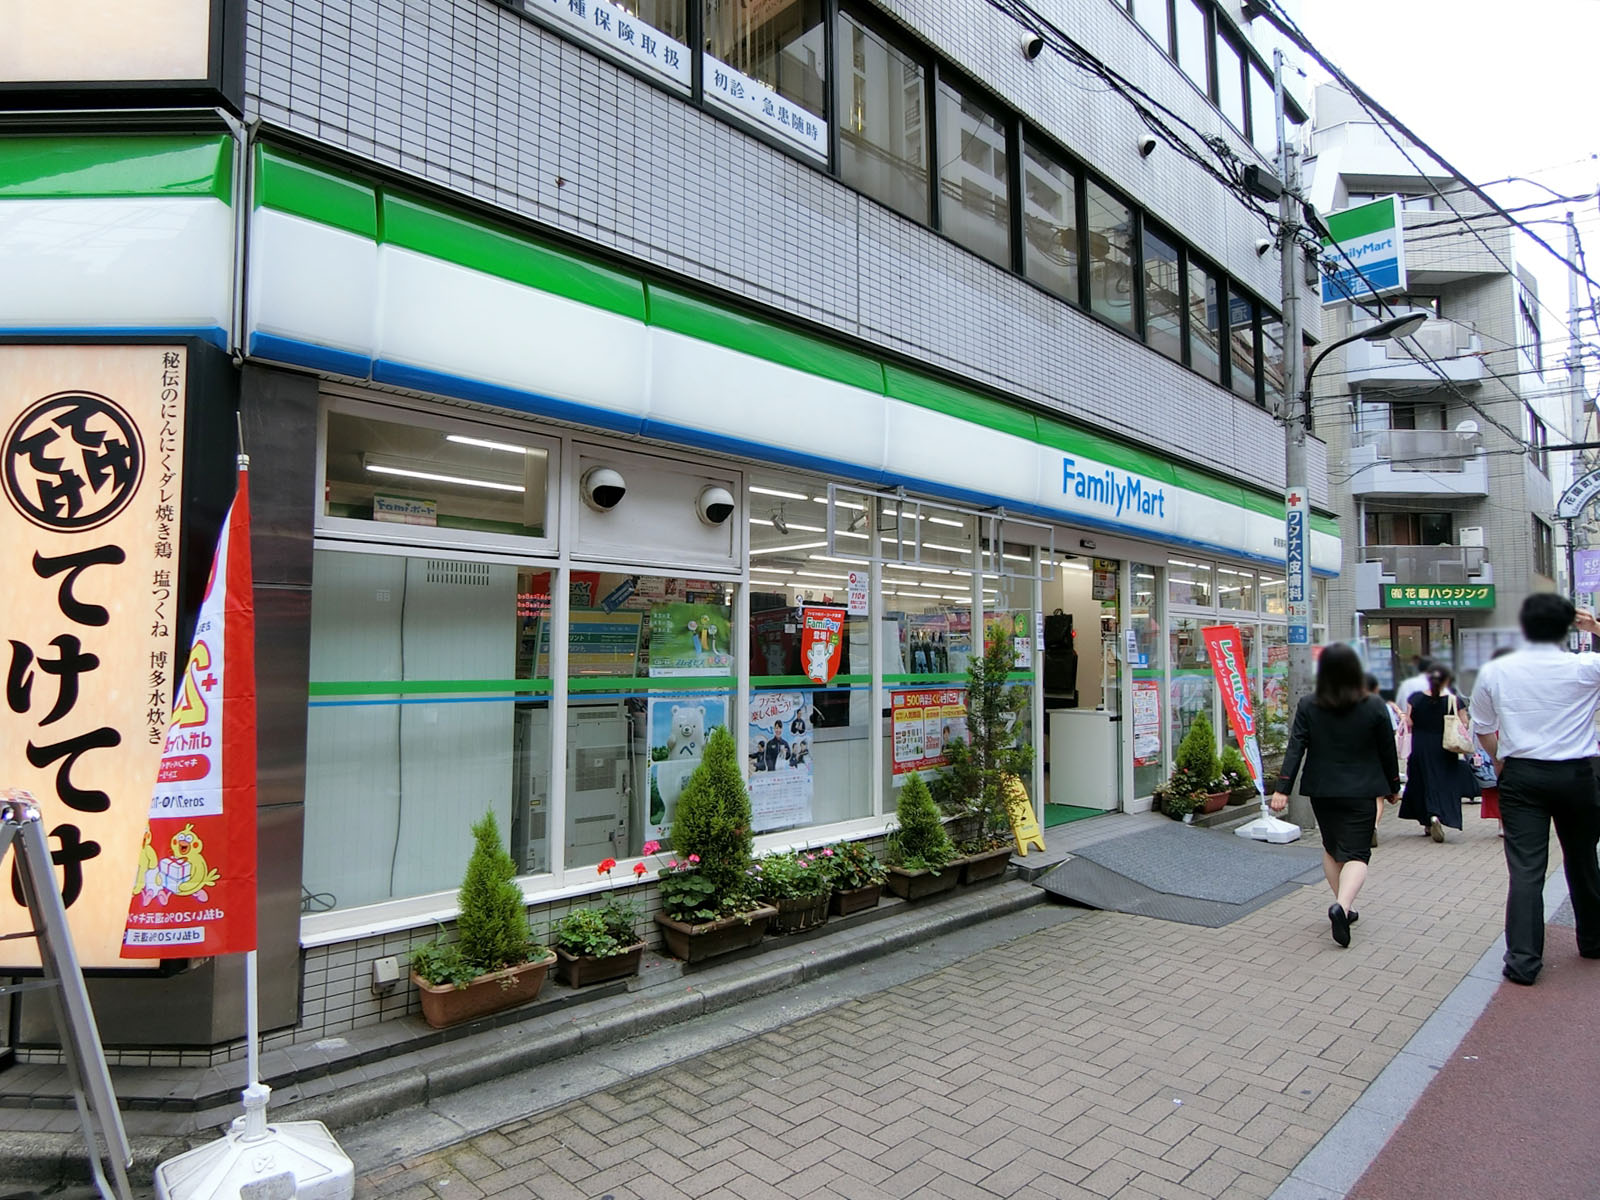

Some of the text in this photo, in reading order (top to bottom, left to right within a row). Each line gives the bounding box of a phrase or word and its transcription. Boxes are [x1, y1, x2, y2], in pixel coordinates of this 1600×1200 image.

[551, 0, 680, 70] 種保険取扱
[713, 69, 819, 142] 初診・急患随時
[154, 351, 181, 560] 秘伝のにんにくダレ焼き鶏
[1062, 456, 1165, 519] FamilyMart
[1287, 511, 1303, 601] ワタナベ皮膚科
[150, 569, 172, 638] 塩つくね
[806, 616, 841, 633] FamiPay
[6, 544, 126, 911] てけてけ
[146, 651, 169, 745] 博多水炊き
